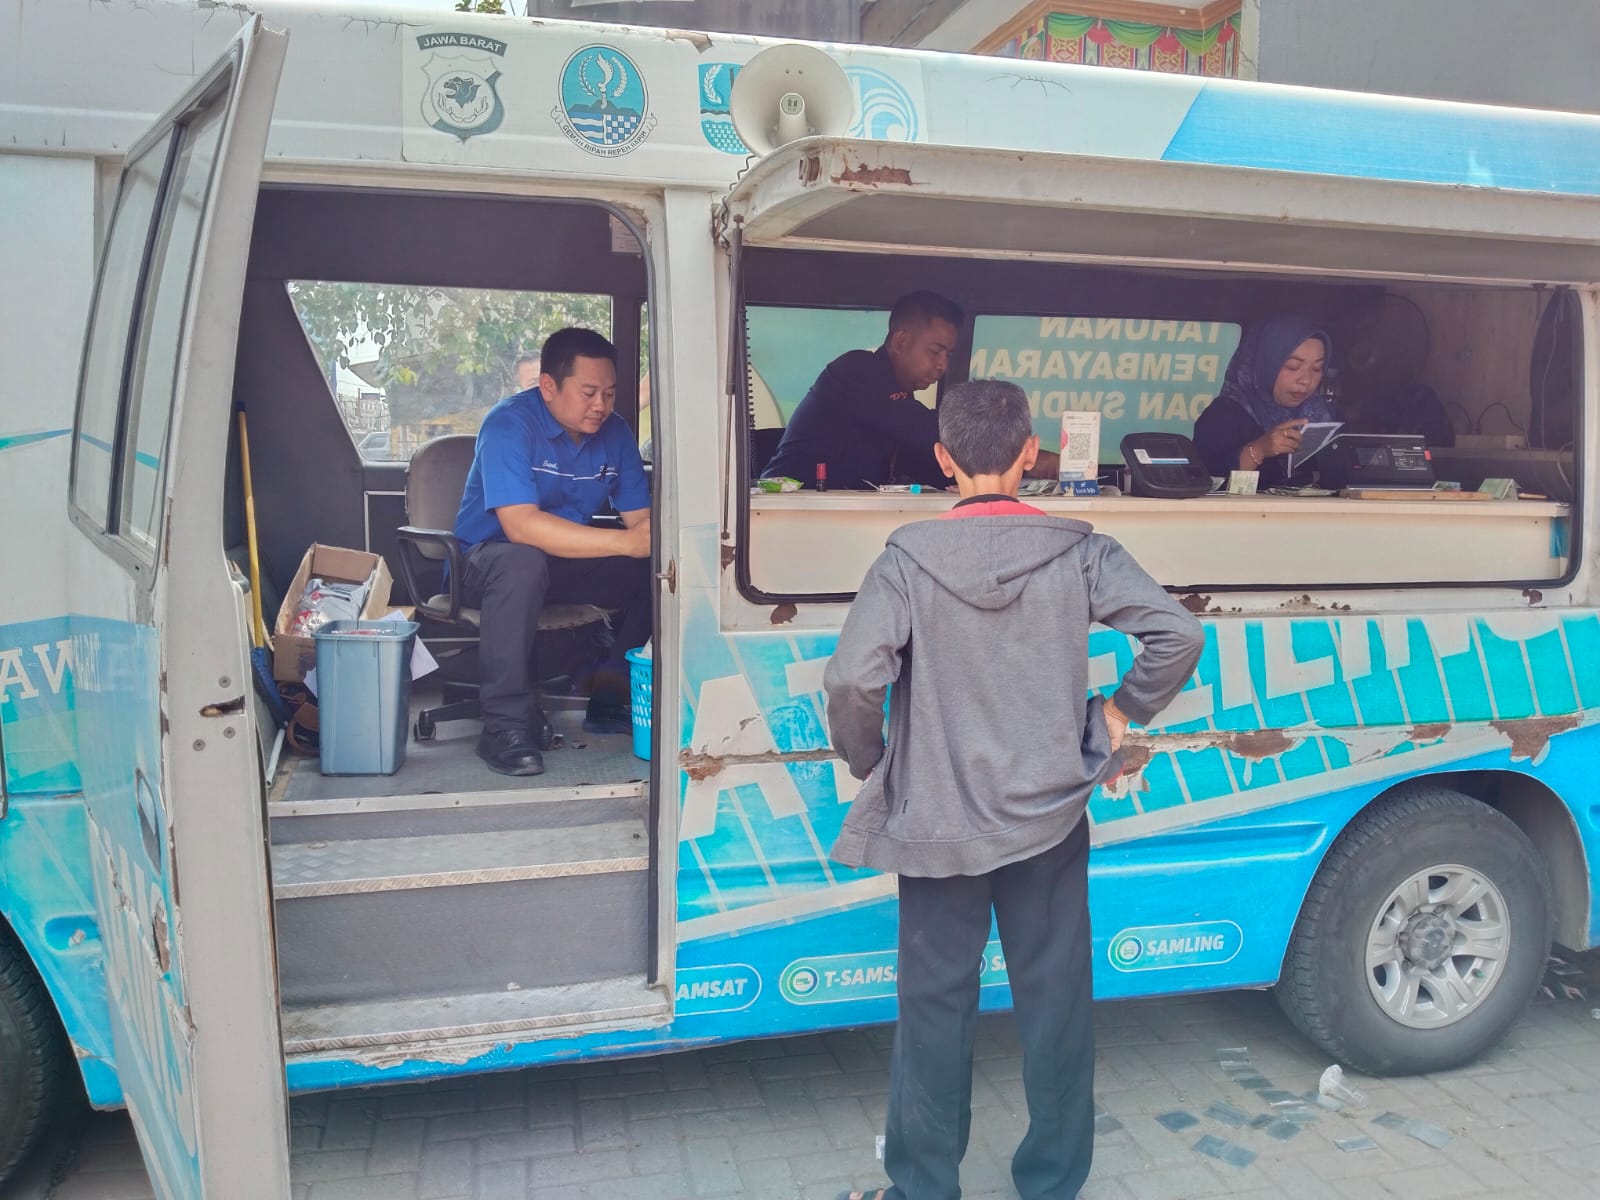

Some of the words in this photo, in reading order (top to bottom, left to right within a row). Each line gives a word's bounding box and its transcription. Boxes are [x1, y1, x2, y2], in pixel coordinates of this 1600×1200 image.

[424, 35, 457, 46] JAWA
[460, 36, 501, 52] BARAT
[563, 125, 584, 146] GEMAH
[584, 145, 606, 156] RIPAH
[607, 144, 631, 156] REPEH
[631, 131, 647, 148] RAPIH
[1146, 934, 1225, 956] SAMLING
[824, 966, 898, 988] T-SAMS
